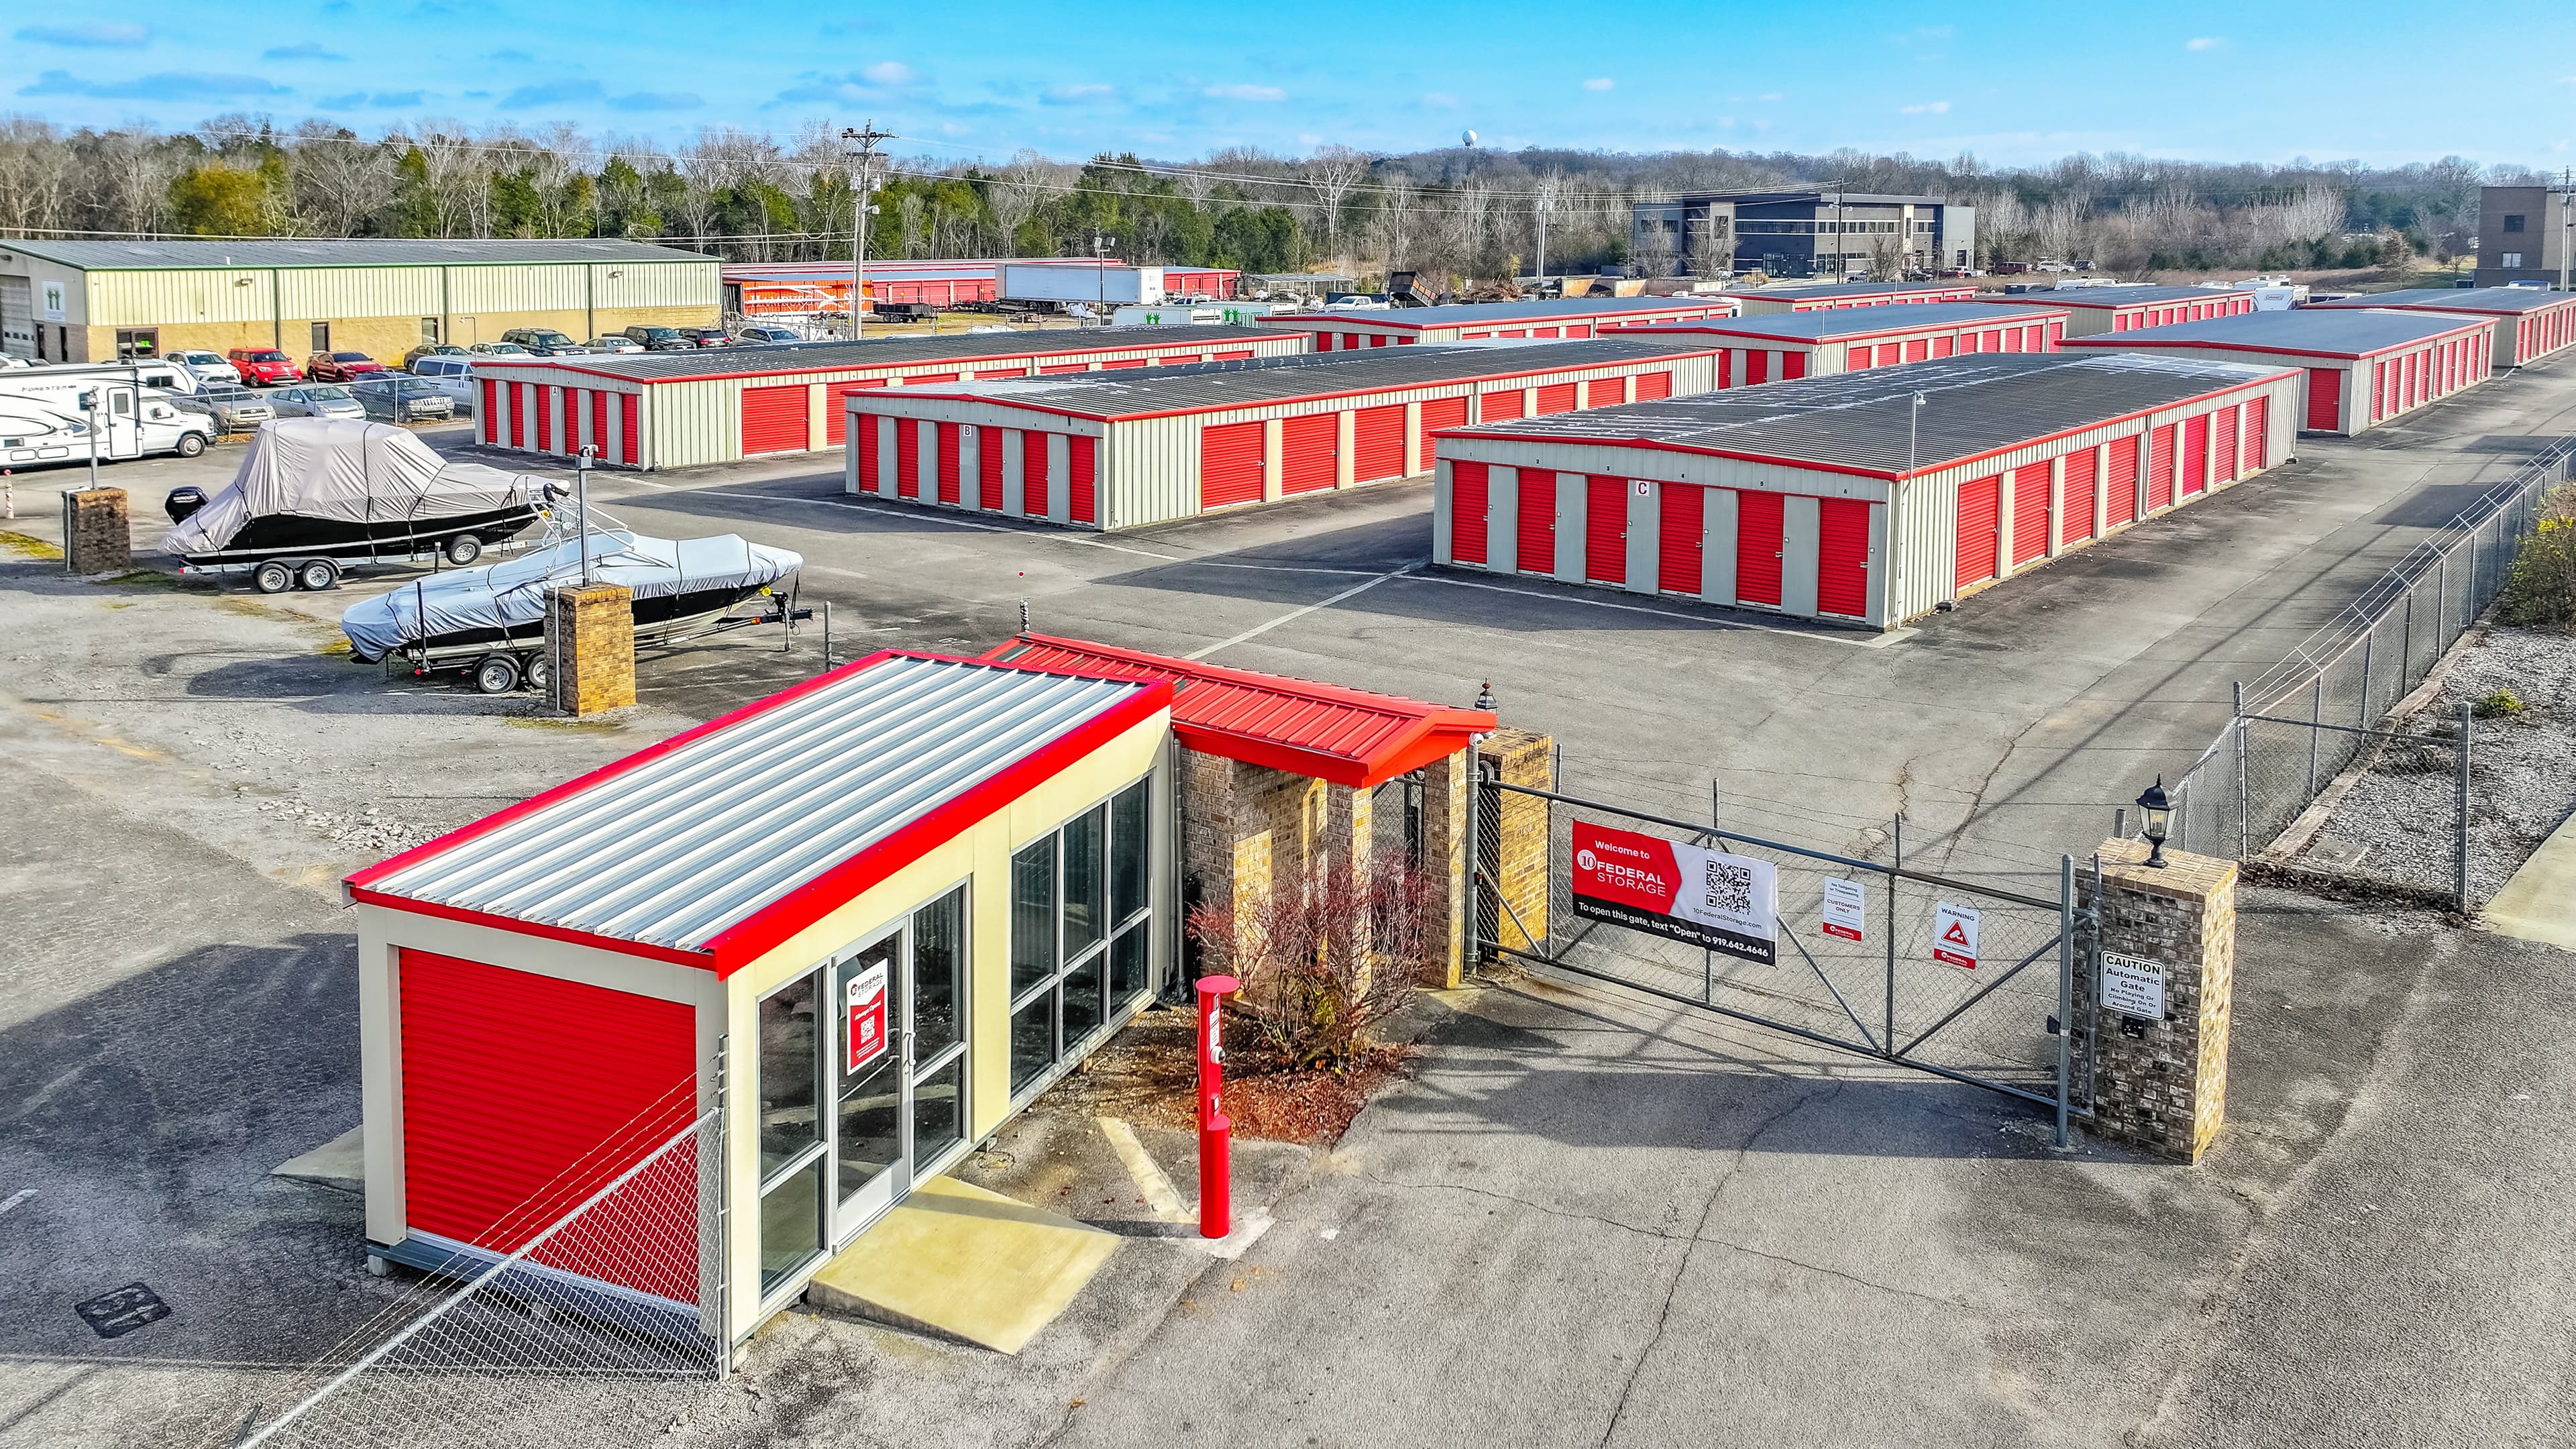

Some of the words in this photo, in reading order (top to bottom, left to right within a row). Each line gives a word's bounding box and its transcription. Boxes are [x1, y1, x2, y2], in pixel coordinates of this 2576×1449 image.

[965, 426, 971, 435] B
[1638, 482, 1648, 495] C
[1595, 840, 1639, 857] Welcome
[1641, 849, 1650, 859] to
[1597, 861, 1666, 885] FEDERAL
[1597, 872, 1666, 897] STORAGE
[1827, 898, 1861, 911] CUSTOMERS
[1693, 908, 1762, 930] 10FederalStorage.com
[1941, 907, 1975, 922] WARNING
[1578, 902, 1589, 912] To
[1590, 906, 1611, 918] open
[1612, 908, 1627, 921] this
[1629, 914, 1650, 928] gate,
[1651, 918, 1668, 932] text
[1670, 924, 1701, 939] "Open"
[1702, 933, 1711, 943] to
[1712, 936, 1769, 957] 919.642.4646
[2106, 955, 2161, 975] CAUTION
[857, 973, 883, 991] FEDERAL
[2106, 968, 2160, 985] Automatic
[2121, 980, 2145, 992] Gate
[2108, 993, 2136, 1006] Climbing
[2121, 989, 2145, 1000] Playing
[2112, 1001, 2135, 1011] Around
[2137, 1006, 2152, 1014] Gate
